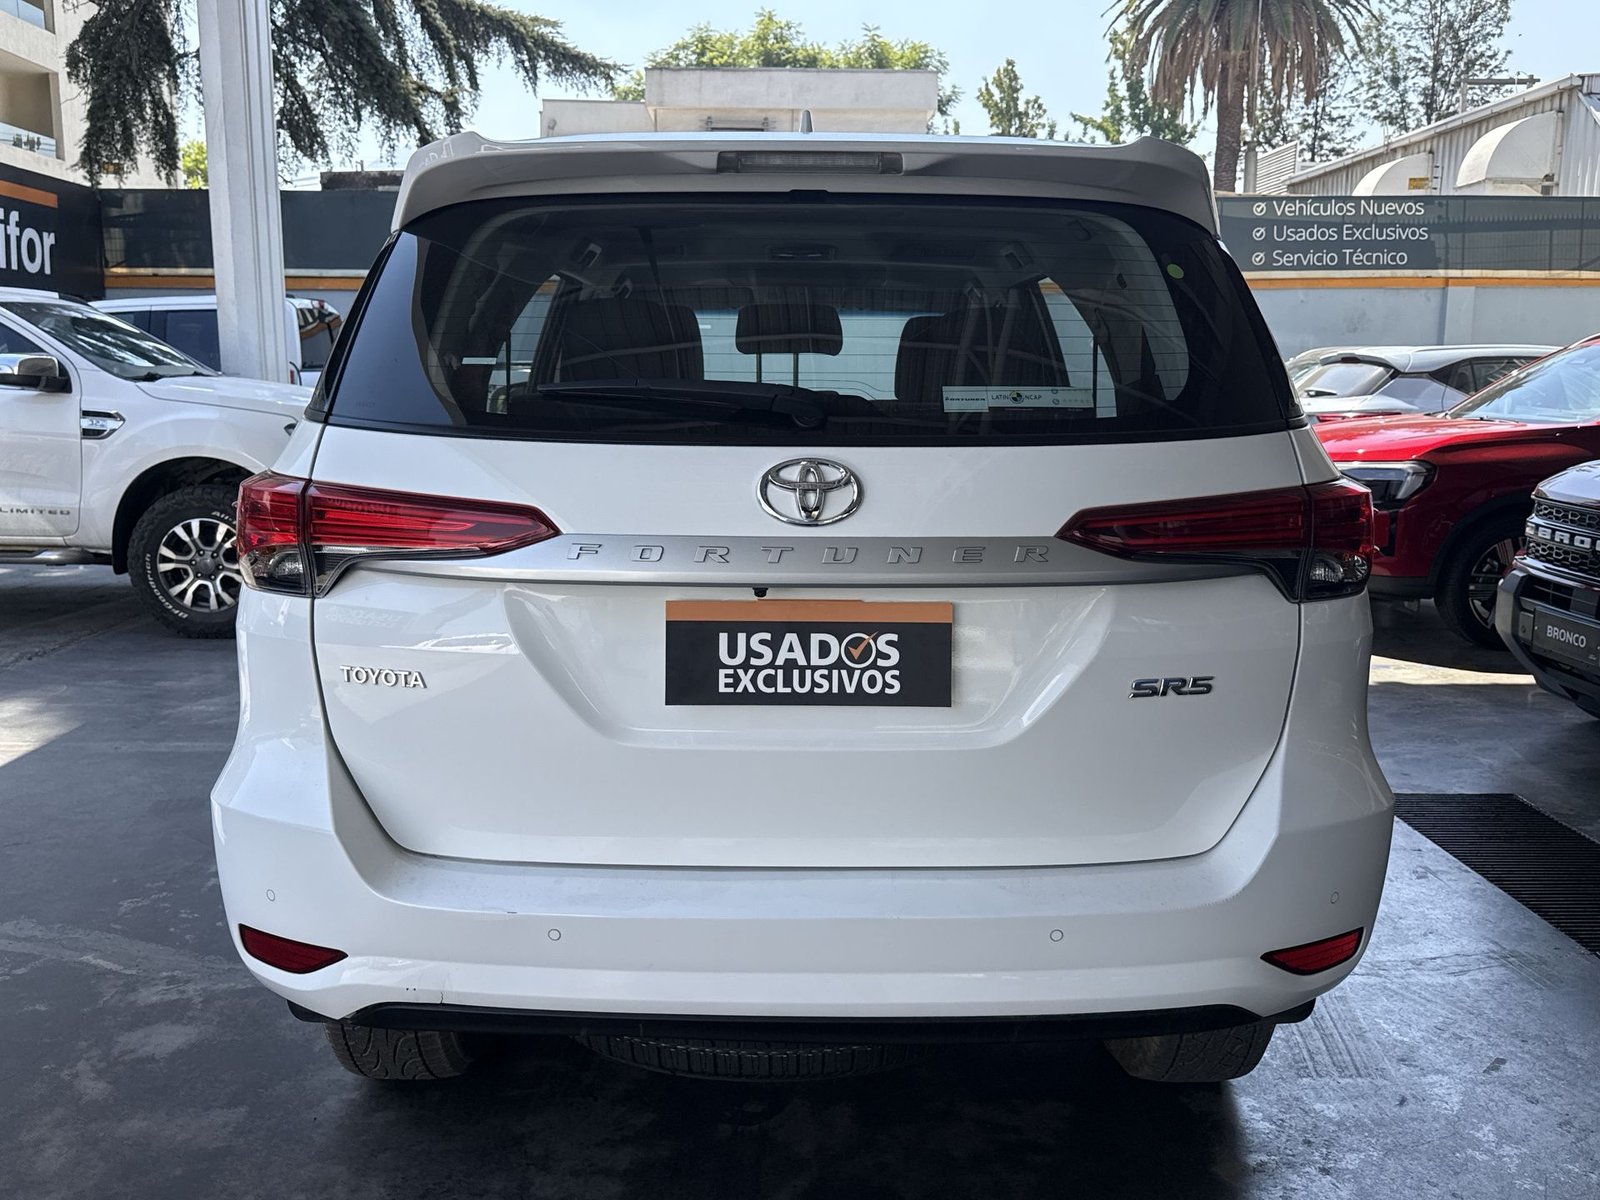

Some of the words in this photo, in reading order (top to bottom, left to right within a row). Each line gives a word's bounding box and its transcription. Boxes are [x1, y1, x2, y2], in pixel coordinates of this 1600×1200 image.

[1273, 199, 1356, 216] Vehículos
[1360, 200, 1425, 216] Nuevos
[1273, 224, 1338, 241] Usados
[1342, 224, 1429, 241] Exclusivos
[1272, 249, 1338, 266] Servicio
[1342, 248, 1408, 266] Técnico
[1538, 526, 1600, 552] BRO
[566, 542, 1049, 564] FORTUNER
[1546, 624, 1587, 648] BRONCO
[718, 631, 901, 668] USADOS
[340, 665, 427, 688] TOYOTA
[718, 668, 901, 695] EXCLUSIVOS
[1128, 676, 1215, 698] SR5
